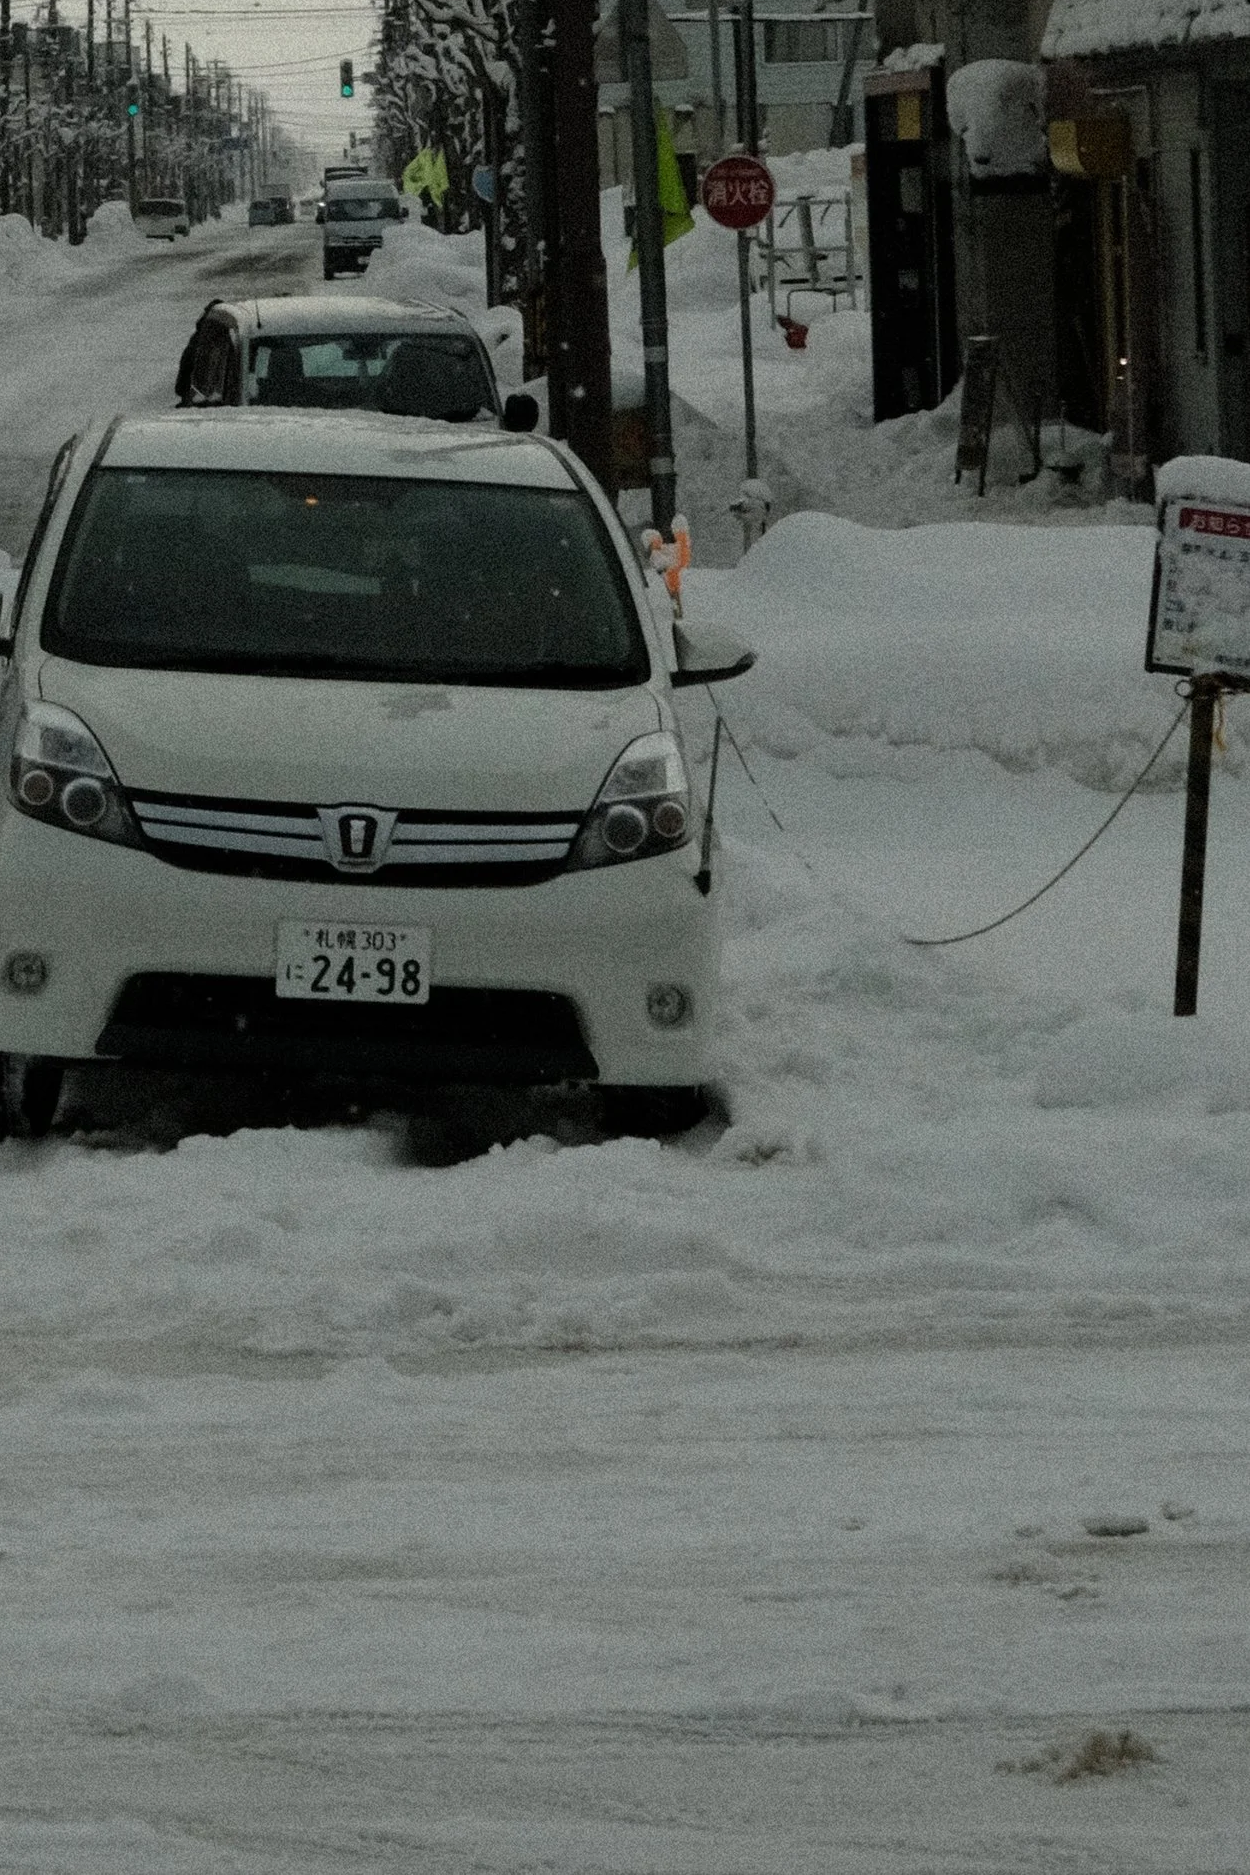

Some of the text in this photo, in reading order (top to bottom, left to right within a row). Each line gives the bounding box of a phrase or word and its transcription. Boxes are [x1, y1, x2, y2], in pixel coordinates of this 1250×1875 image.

[707, 178, 770, 206] 消火栓
[311, 954, 421, 997] 24-98
